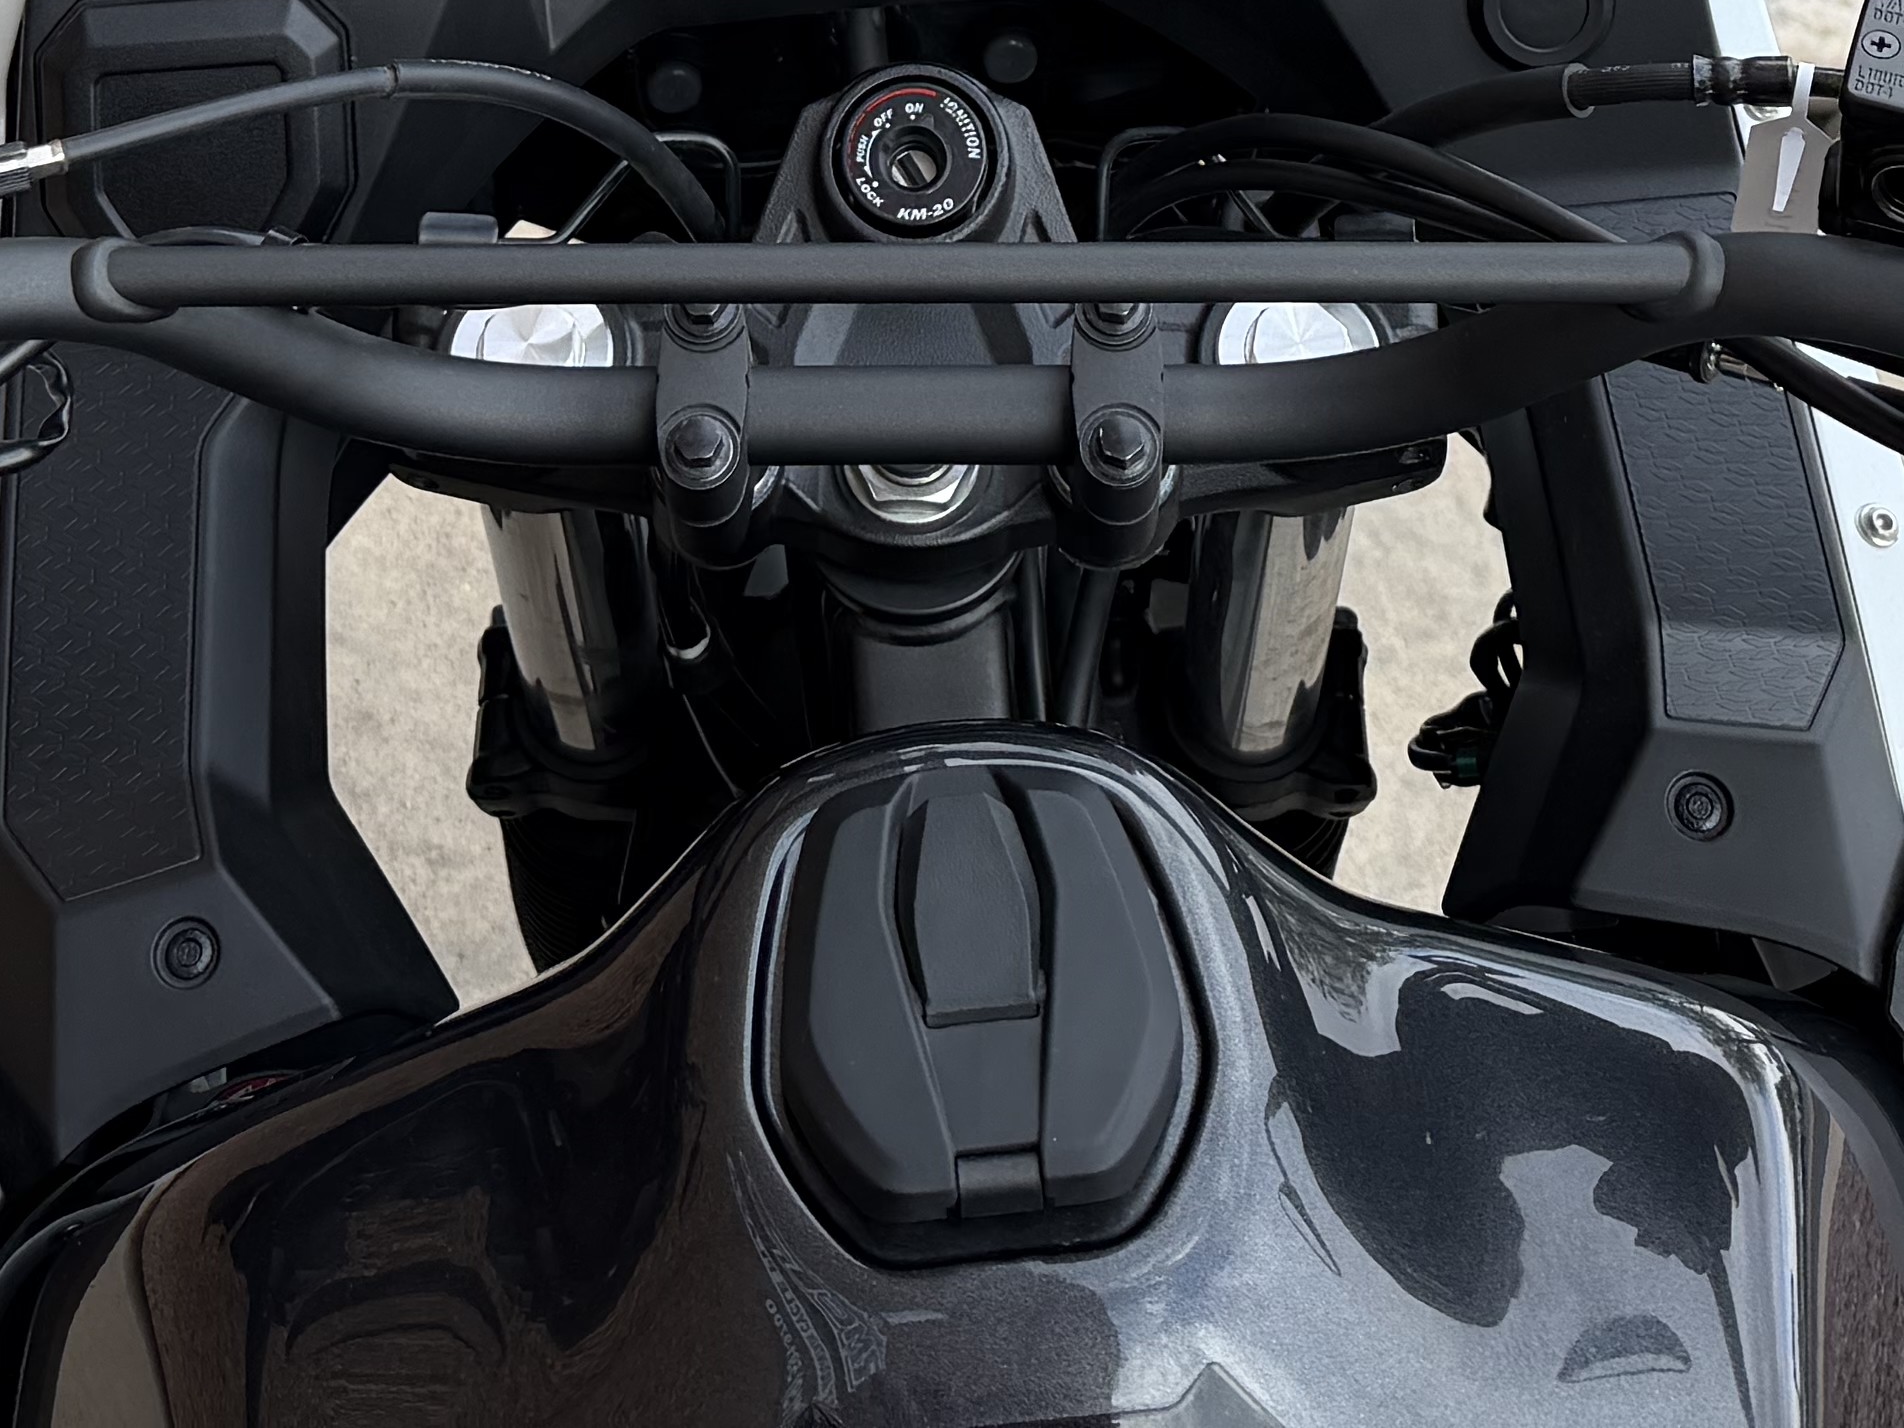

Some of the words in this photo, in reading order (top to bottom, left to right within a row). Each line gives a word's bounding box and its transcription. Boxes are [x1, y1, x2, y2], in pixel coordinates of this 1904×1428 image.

[873, 109, 893, 127] OFF
[905, 103, 924, 114] ON
[940, 97, 981, 159] IGNITION
[856, 135, 869, 163] PUSH
[856, 177, 884, 207] LOCK
[897, 198, 954, 220] KM-20
